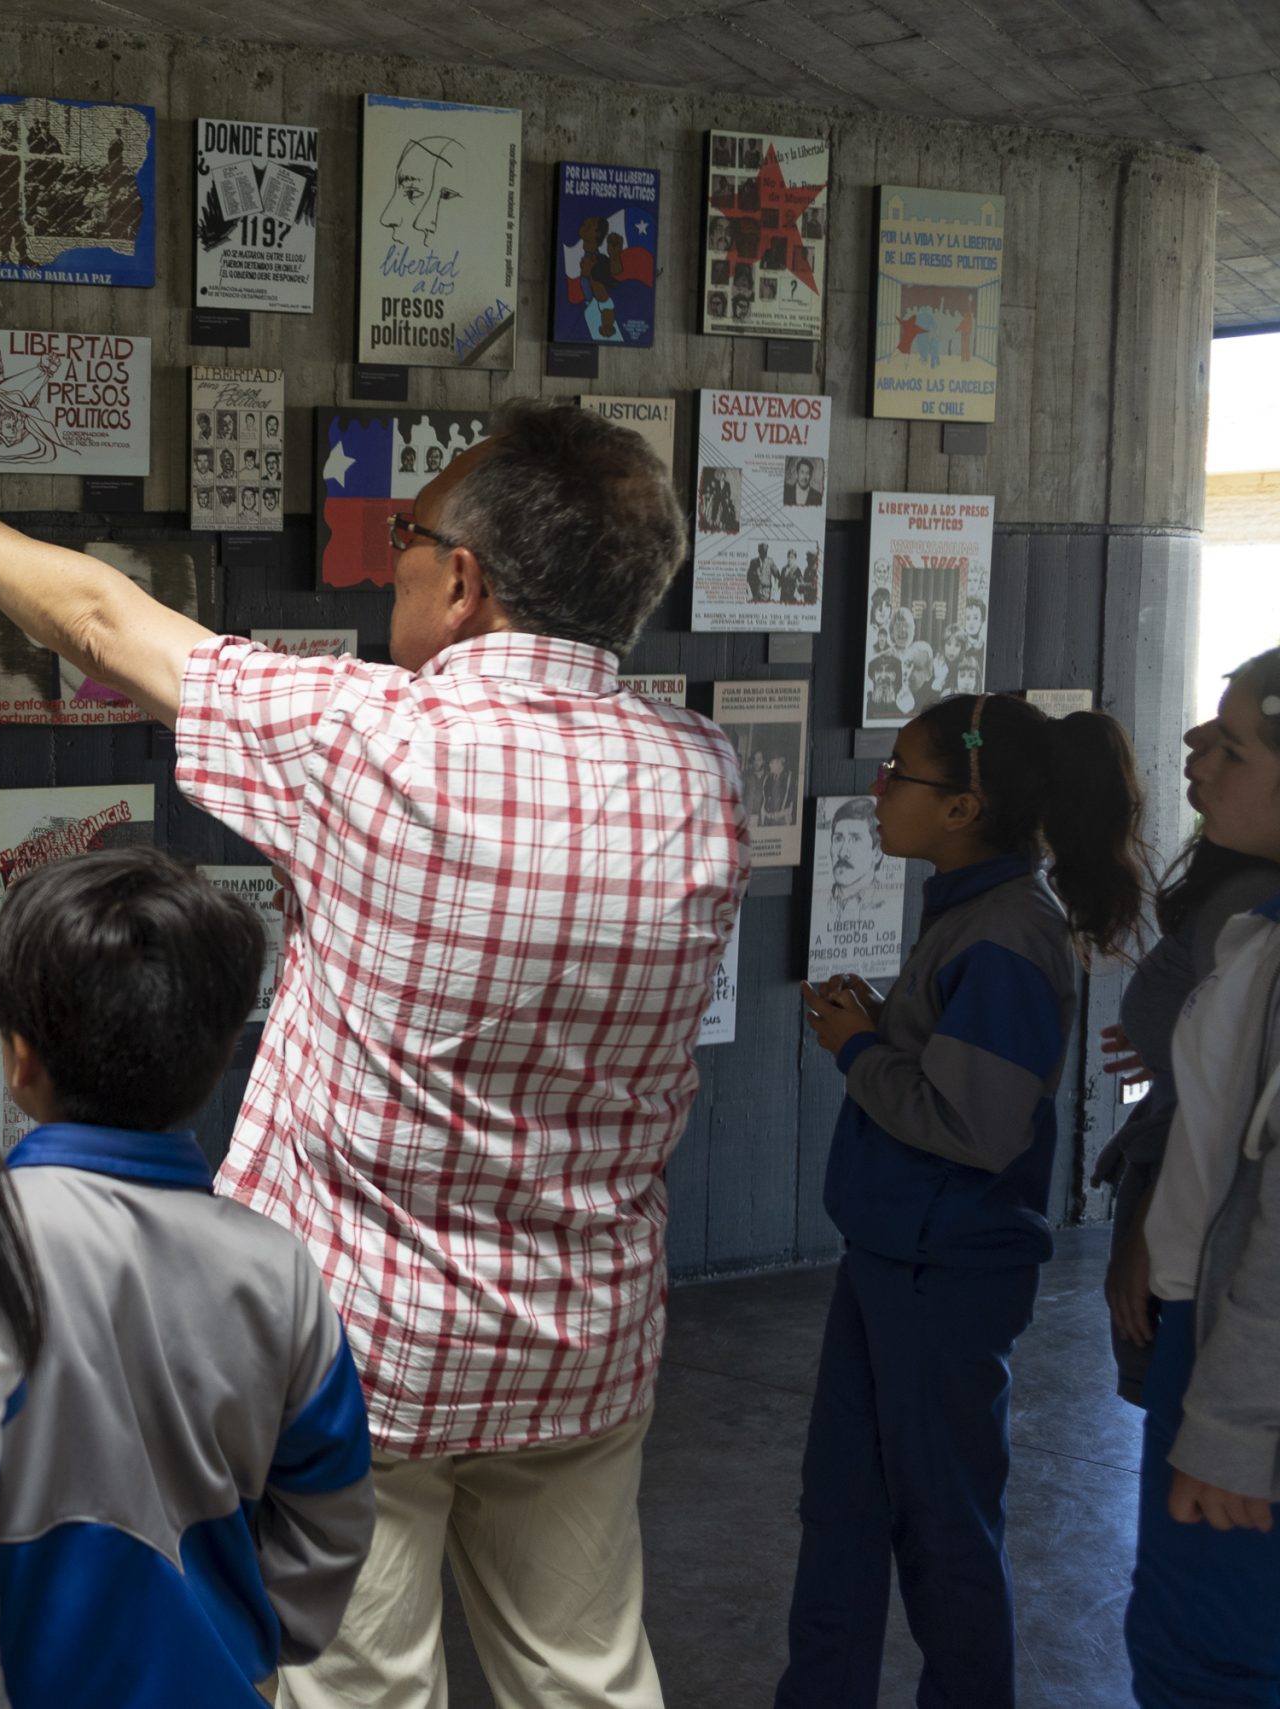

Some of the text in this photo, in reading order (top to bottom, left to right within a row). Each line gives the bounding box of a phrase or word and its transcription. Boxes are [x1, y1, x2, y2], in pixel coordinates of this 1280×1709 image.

[205, 122, 318, 162] DONDE ESTAN
[565, 165, 580, 179] POR
[582, 167, 590, 180] LA
[609, 169, 614, 181] Y
[615, 170, 623, 183] LA
[565, 180, 656, 202] DE LOS PRESOS POLITICOS
[240, 215, 292, 248] 119?
[880, 230, 1002, 251] POR LA VIDA Y LA LIBERTAD
[380, 243, 461, 279] libertad
[885, 251, 998, 270] DE LOS PRESOS POLITICOS
[22, 268, 42, 281] NOS
[44, 271, 74, 283] DARA
[75, 272, 89, 284] LA
[91, 272, 112, 285] PAZ
[412, 276, 455, 296] a los
[382, 297, 445, 321] presos
[455, 298, 513, 360] AHORA
[10, 332, 134, 362] LIBERTAD
[65, 360, 130, 386] A LOS
[47, 382, 131, 407] PRESOS
[877, 377, 995, 394] ABRAMOS LAS CARCELES
[712, 393, 821, 420] ¡SALVEMOS
[922, 401, 965, 415] DE CHILE
[55, 407, 131, 430] POLITICOS
[721, 421, 809, 446] SU VIDA!
[878, 502, 990, 518] LIBERTAD A LOS PRESOS
[908, 517, 963, 532] POLITICOS
[634, 680, 649, 694] DEL
[652, 680, 684, 694] PUEBLO
[70, 699, 93, 710] con
[81, 712, 105, 725] que
[107, 710, 140, 722] hable
[827, 920, 875, 933] LIBERTAD
[815, 930, 897, 945] A TODOS LOS
[810, 943, 901, 961] PRESOS POLITICOS
